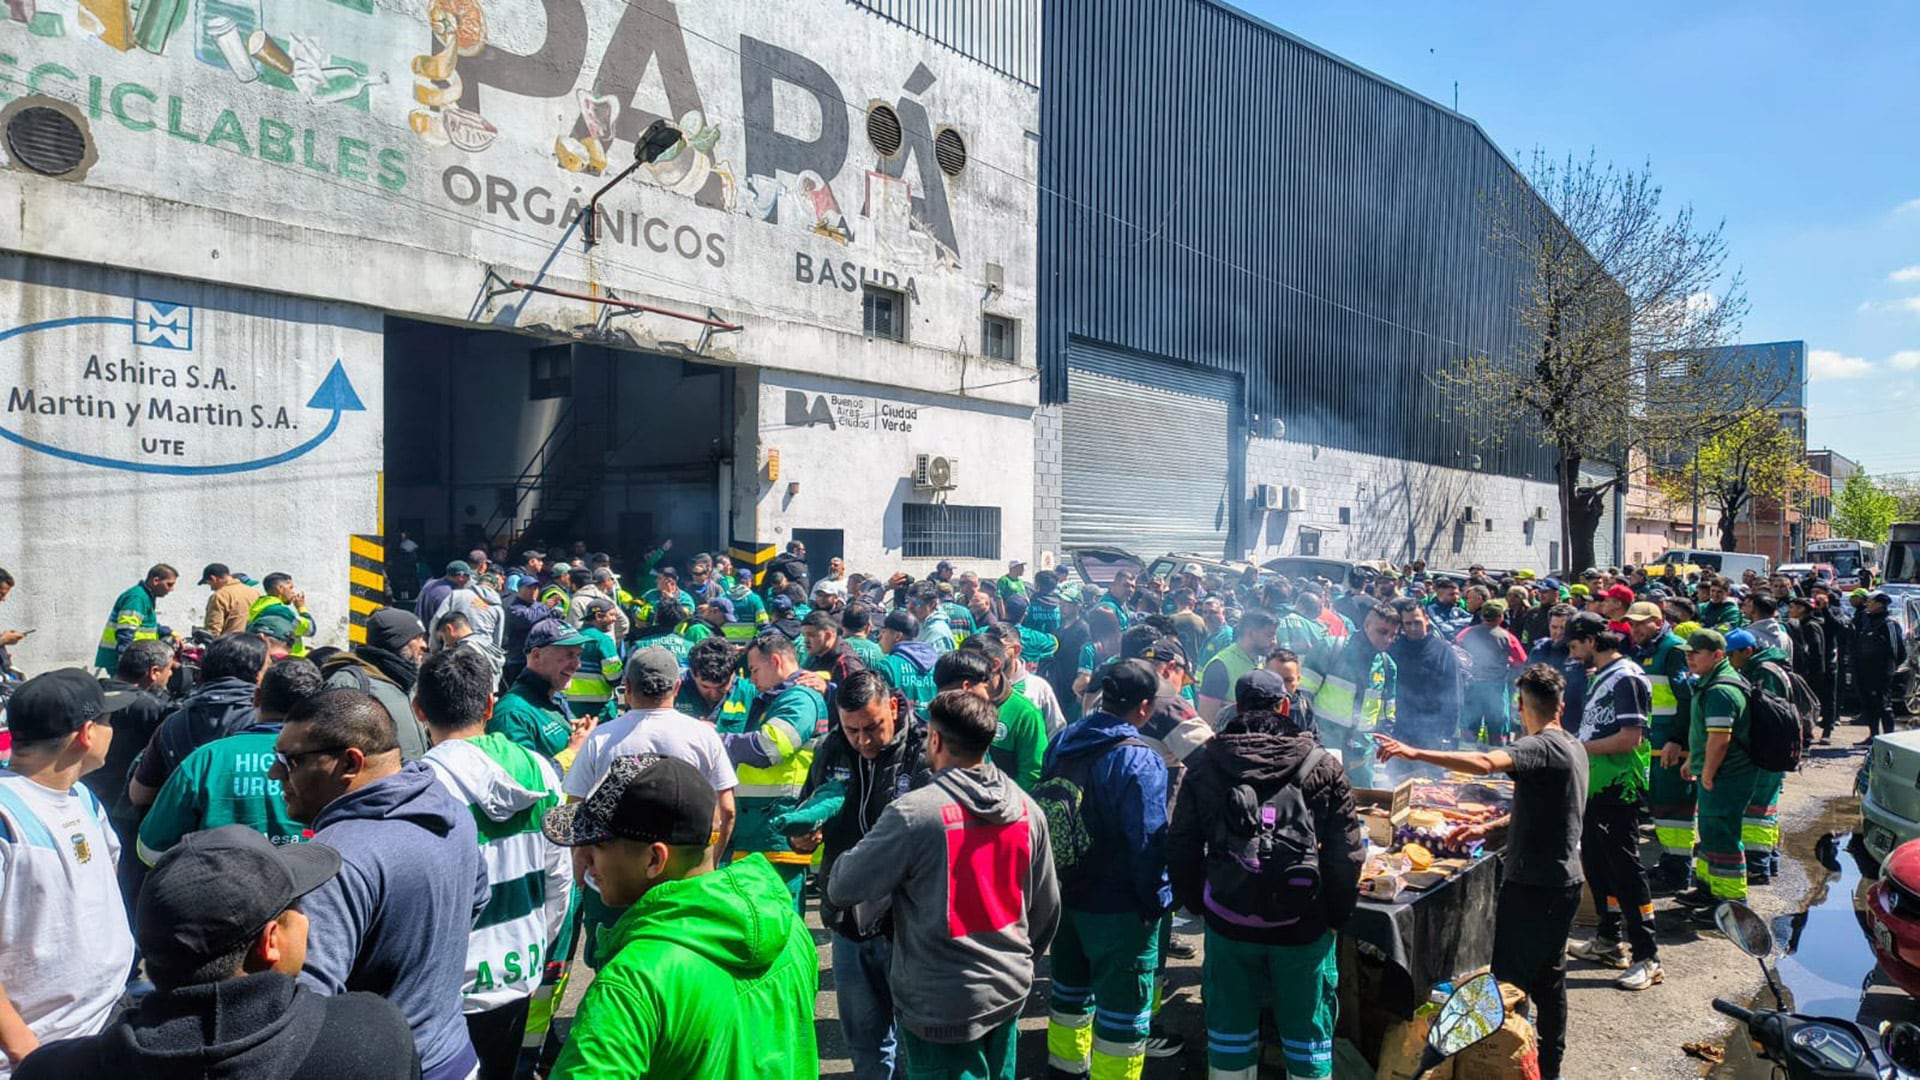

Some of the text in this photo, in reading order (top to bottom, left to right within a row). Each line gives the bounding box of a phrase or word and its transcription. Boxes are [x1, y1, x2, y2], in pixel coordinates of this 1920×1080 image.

[441, 164, 726, 268] ORGÁNICOS
[83, 354, 237, 391] Ashira S.A.
[7, 386, 298, 430] Martin y Martin S.A.
[785, 389, 836, 431] BA
[831, 395, 864, 409] Buenos
[881, 404, 917, 420] Ciudad
[838, 416, 869, 429] Ciudad
[881, 418, 912, 432] Verde
[141, 438, 185, 456] UTE
[235, 753, 276, 773] HIG
